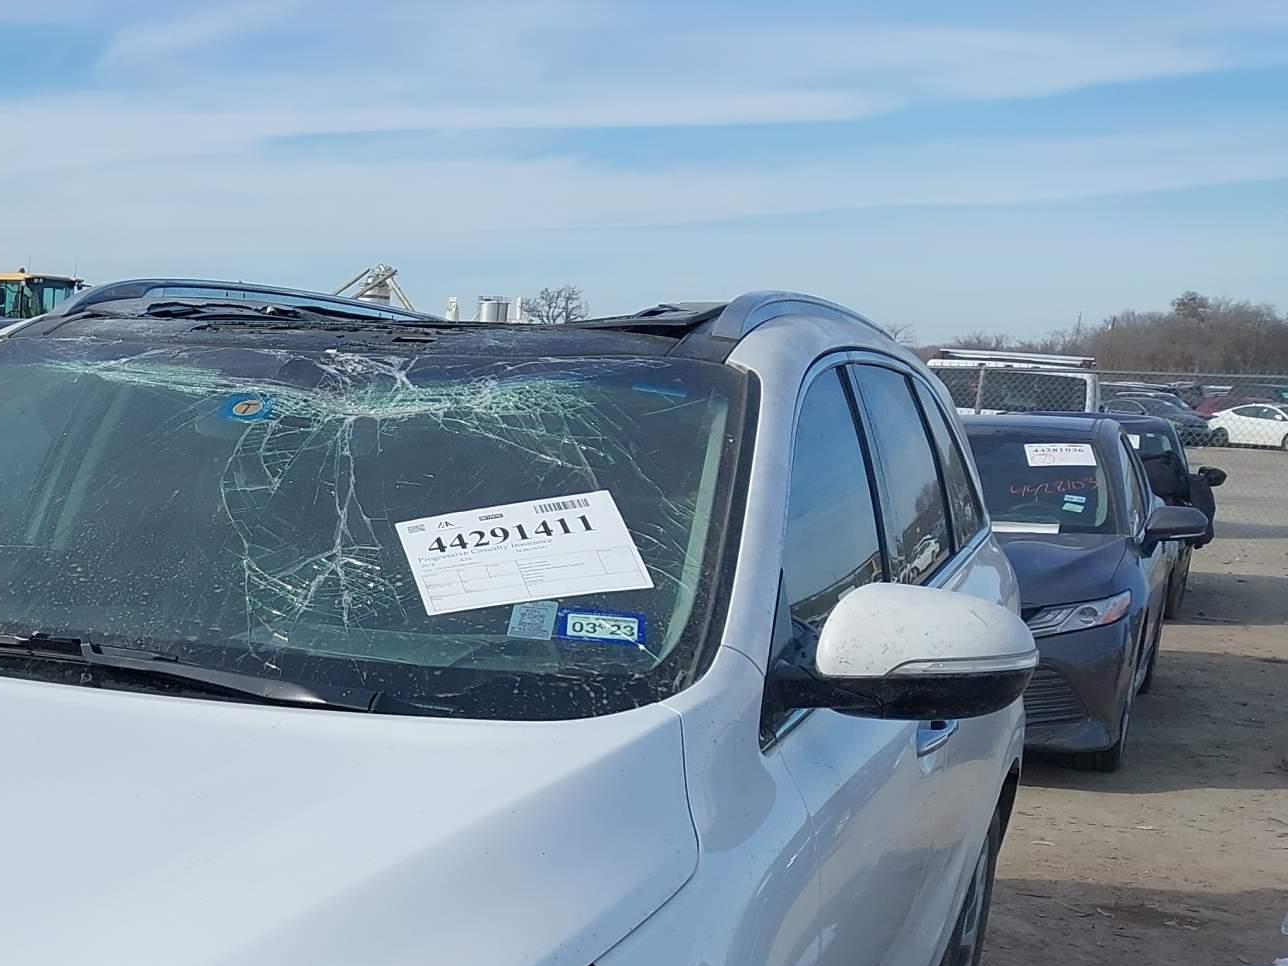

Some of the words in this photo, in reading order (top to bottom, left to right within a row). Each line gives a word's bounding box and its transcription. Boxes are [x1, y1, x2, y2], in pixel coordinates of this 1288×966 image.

[428, 514, 598, 553] 44291411
[417, 551, 469, 563] Progressive
[470, 544, 508, 555] Casualty
[510, 537, 553, 549] Insurance
[572, 620, 598, 634] 03
[609, 624, 636, 637] 23
